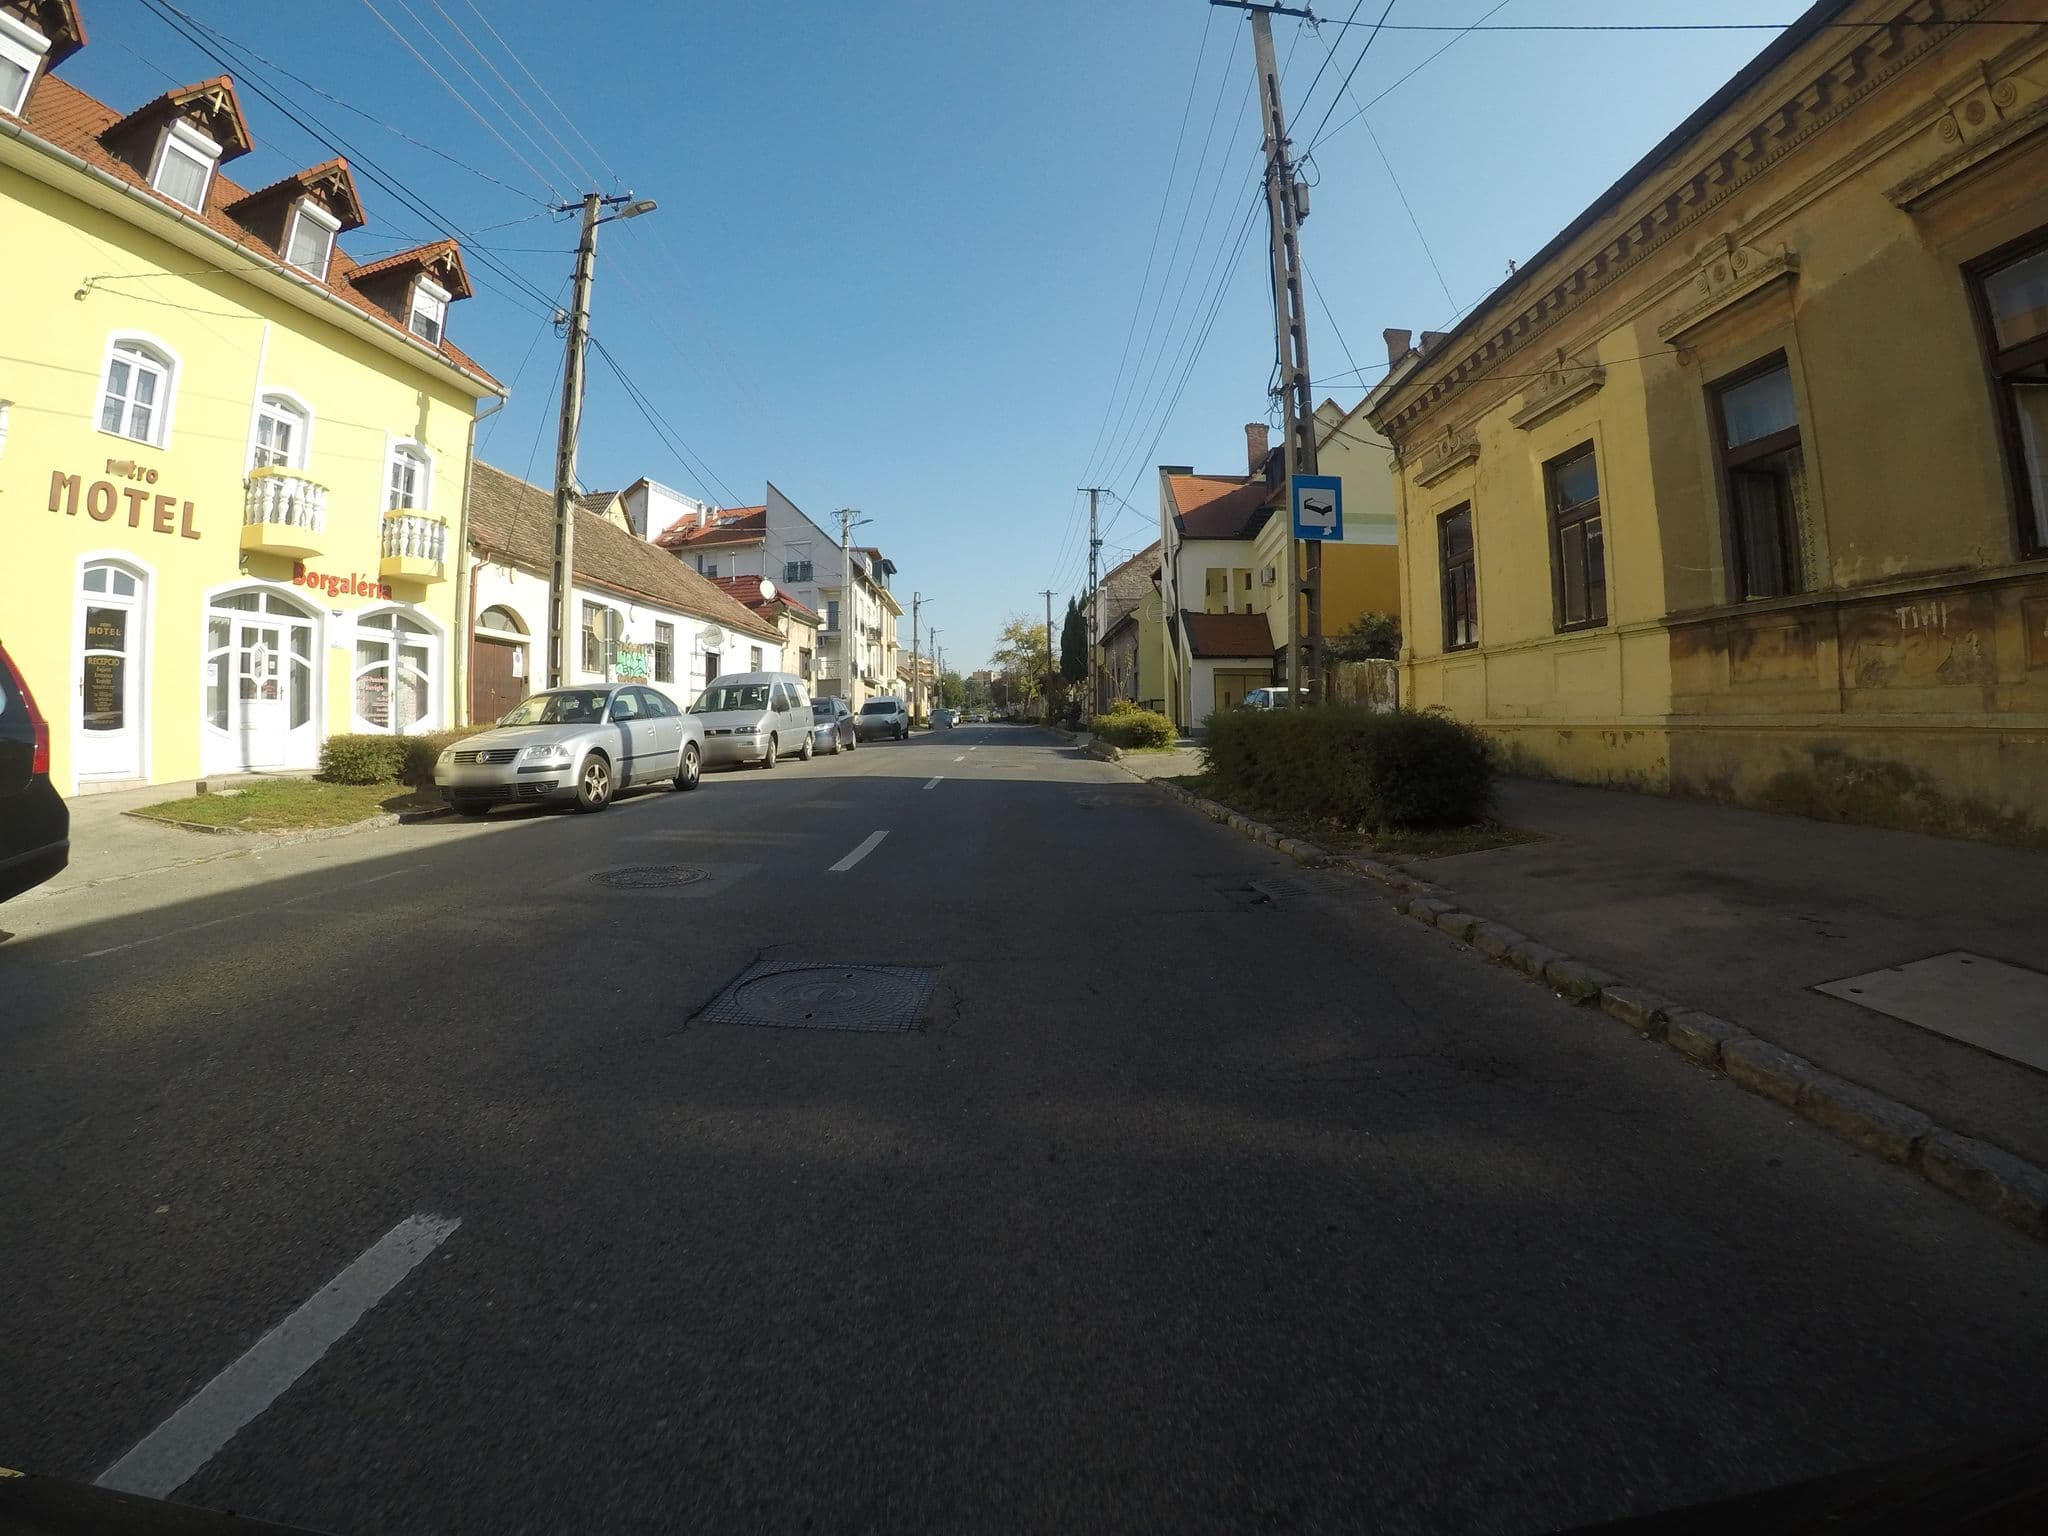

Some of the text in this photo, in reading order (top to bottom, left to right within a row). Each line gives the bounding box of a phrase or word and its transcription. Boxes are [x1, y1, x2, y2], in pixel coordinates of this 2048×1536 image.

[105, 458, 159, 485] rtro
[48, 470, 202, 540] MOTEL
[292, 560, 393, 600] Borgaléria
[88, 626, 121, 636] MOTEL
